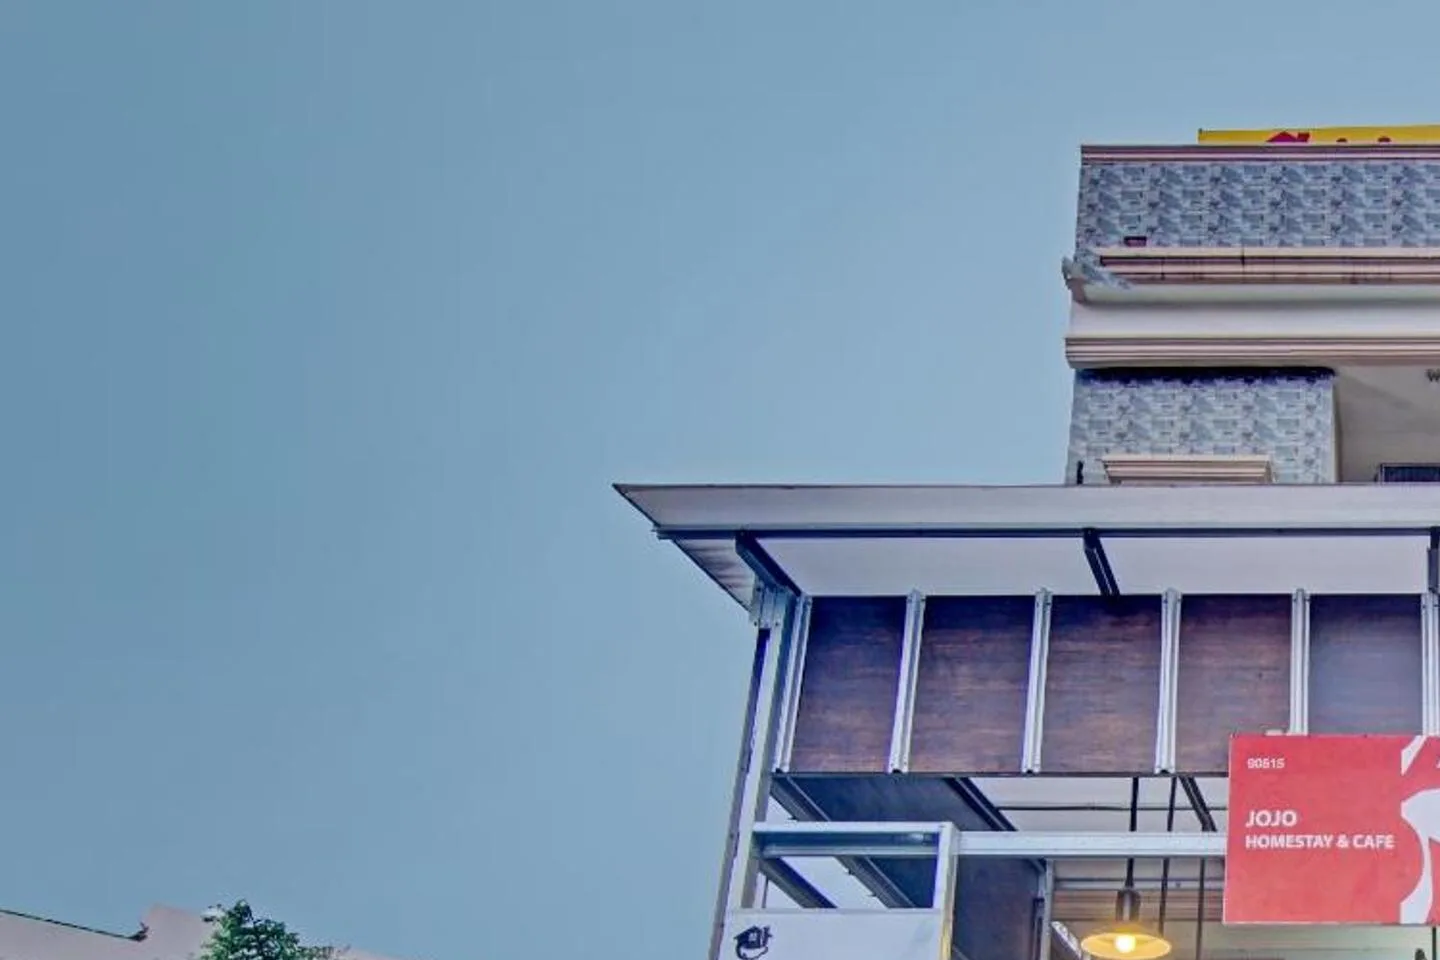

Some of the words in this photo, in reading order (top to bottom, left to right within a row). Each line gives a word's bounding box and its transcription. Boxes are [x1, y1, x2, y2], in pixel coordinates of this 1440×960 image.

[1245, 809, 1298, 828] JOJO
[1245, 834, 1334, 849] HOMESTAY
[1336, 834, 1350, 849] &
[1352, 834, 1395, 849] CAFE
